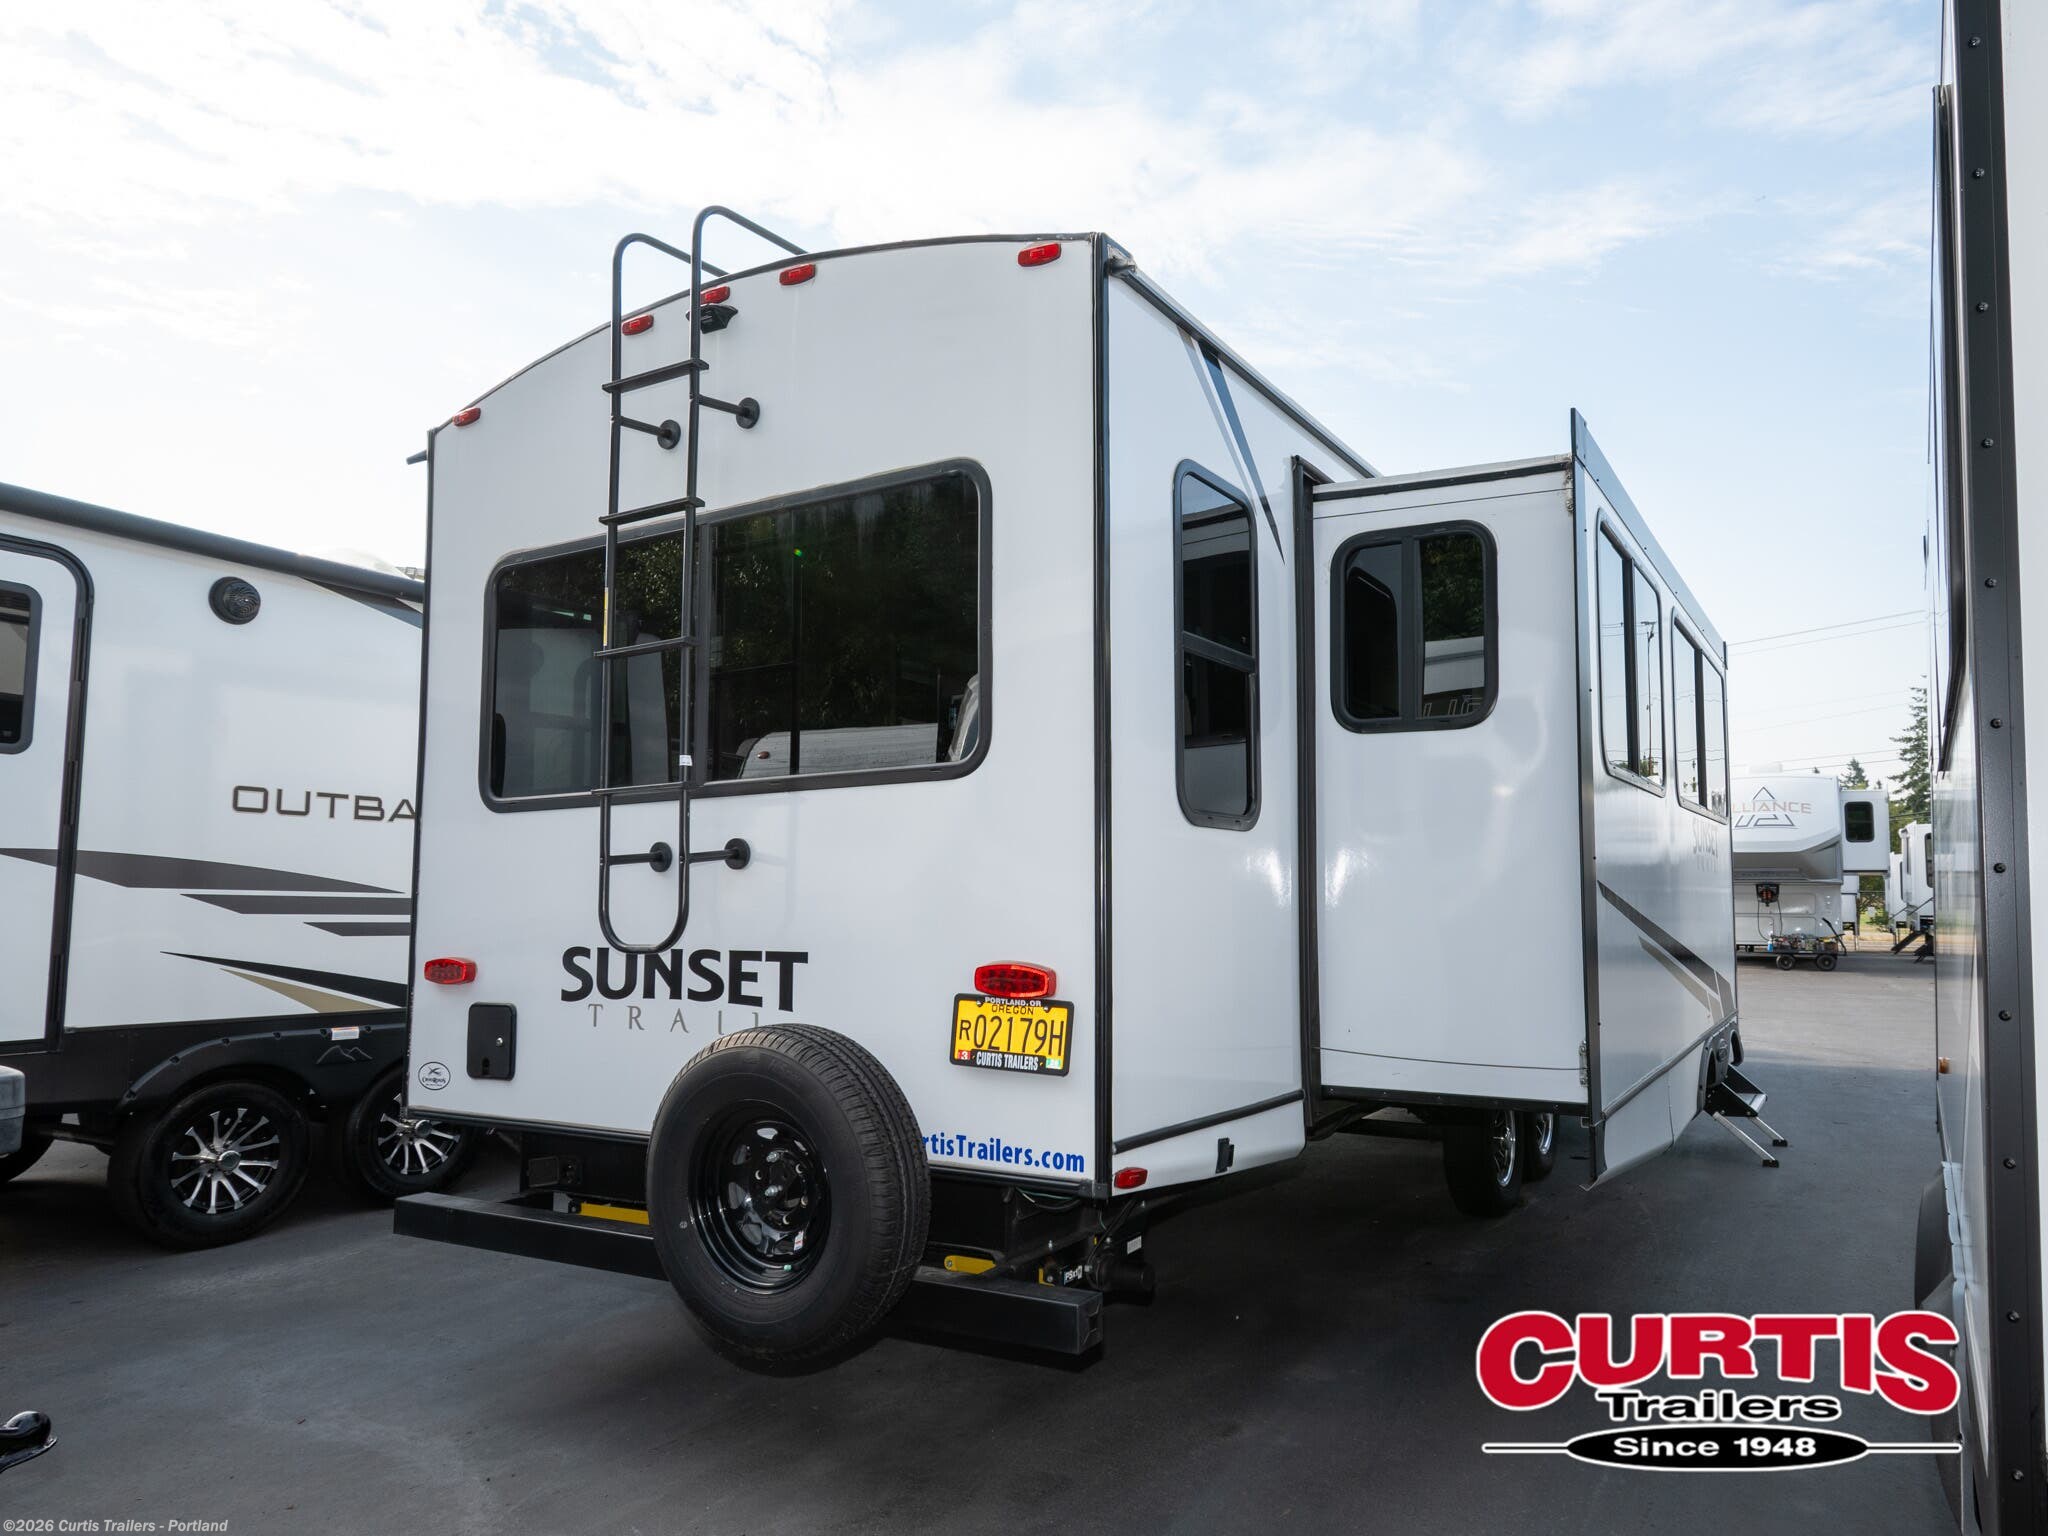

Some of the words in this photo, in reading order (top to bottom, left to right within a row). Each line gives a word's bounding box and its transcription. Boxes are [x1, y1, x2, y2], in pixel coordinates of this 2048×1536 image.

[232, 785, 416, 822] OUTBA
[560, 946, 809, 1012] SUNSET
[991, 1004, 1034, 1015] OREGON
[1030, 999, 1042, 1007] OR
[962, 1051, 969, 1060] 3
[976, 1051, 1002, 1067] CURTIS
[1004, 1054, 1039, 1071] TRAILERS
